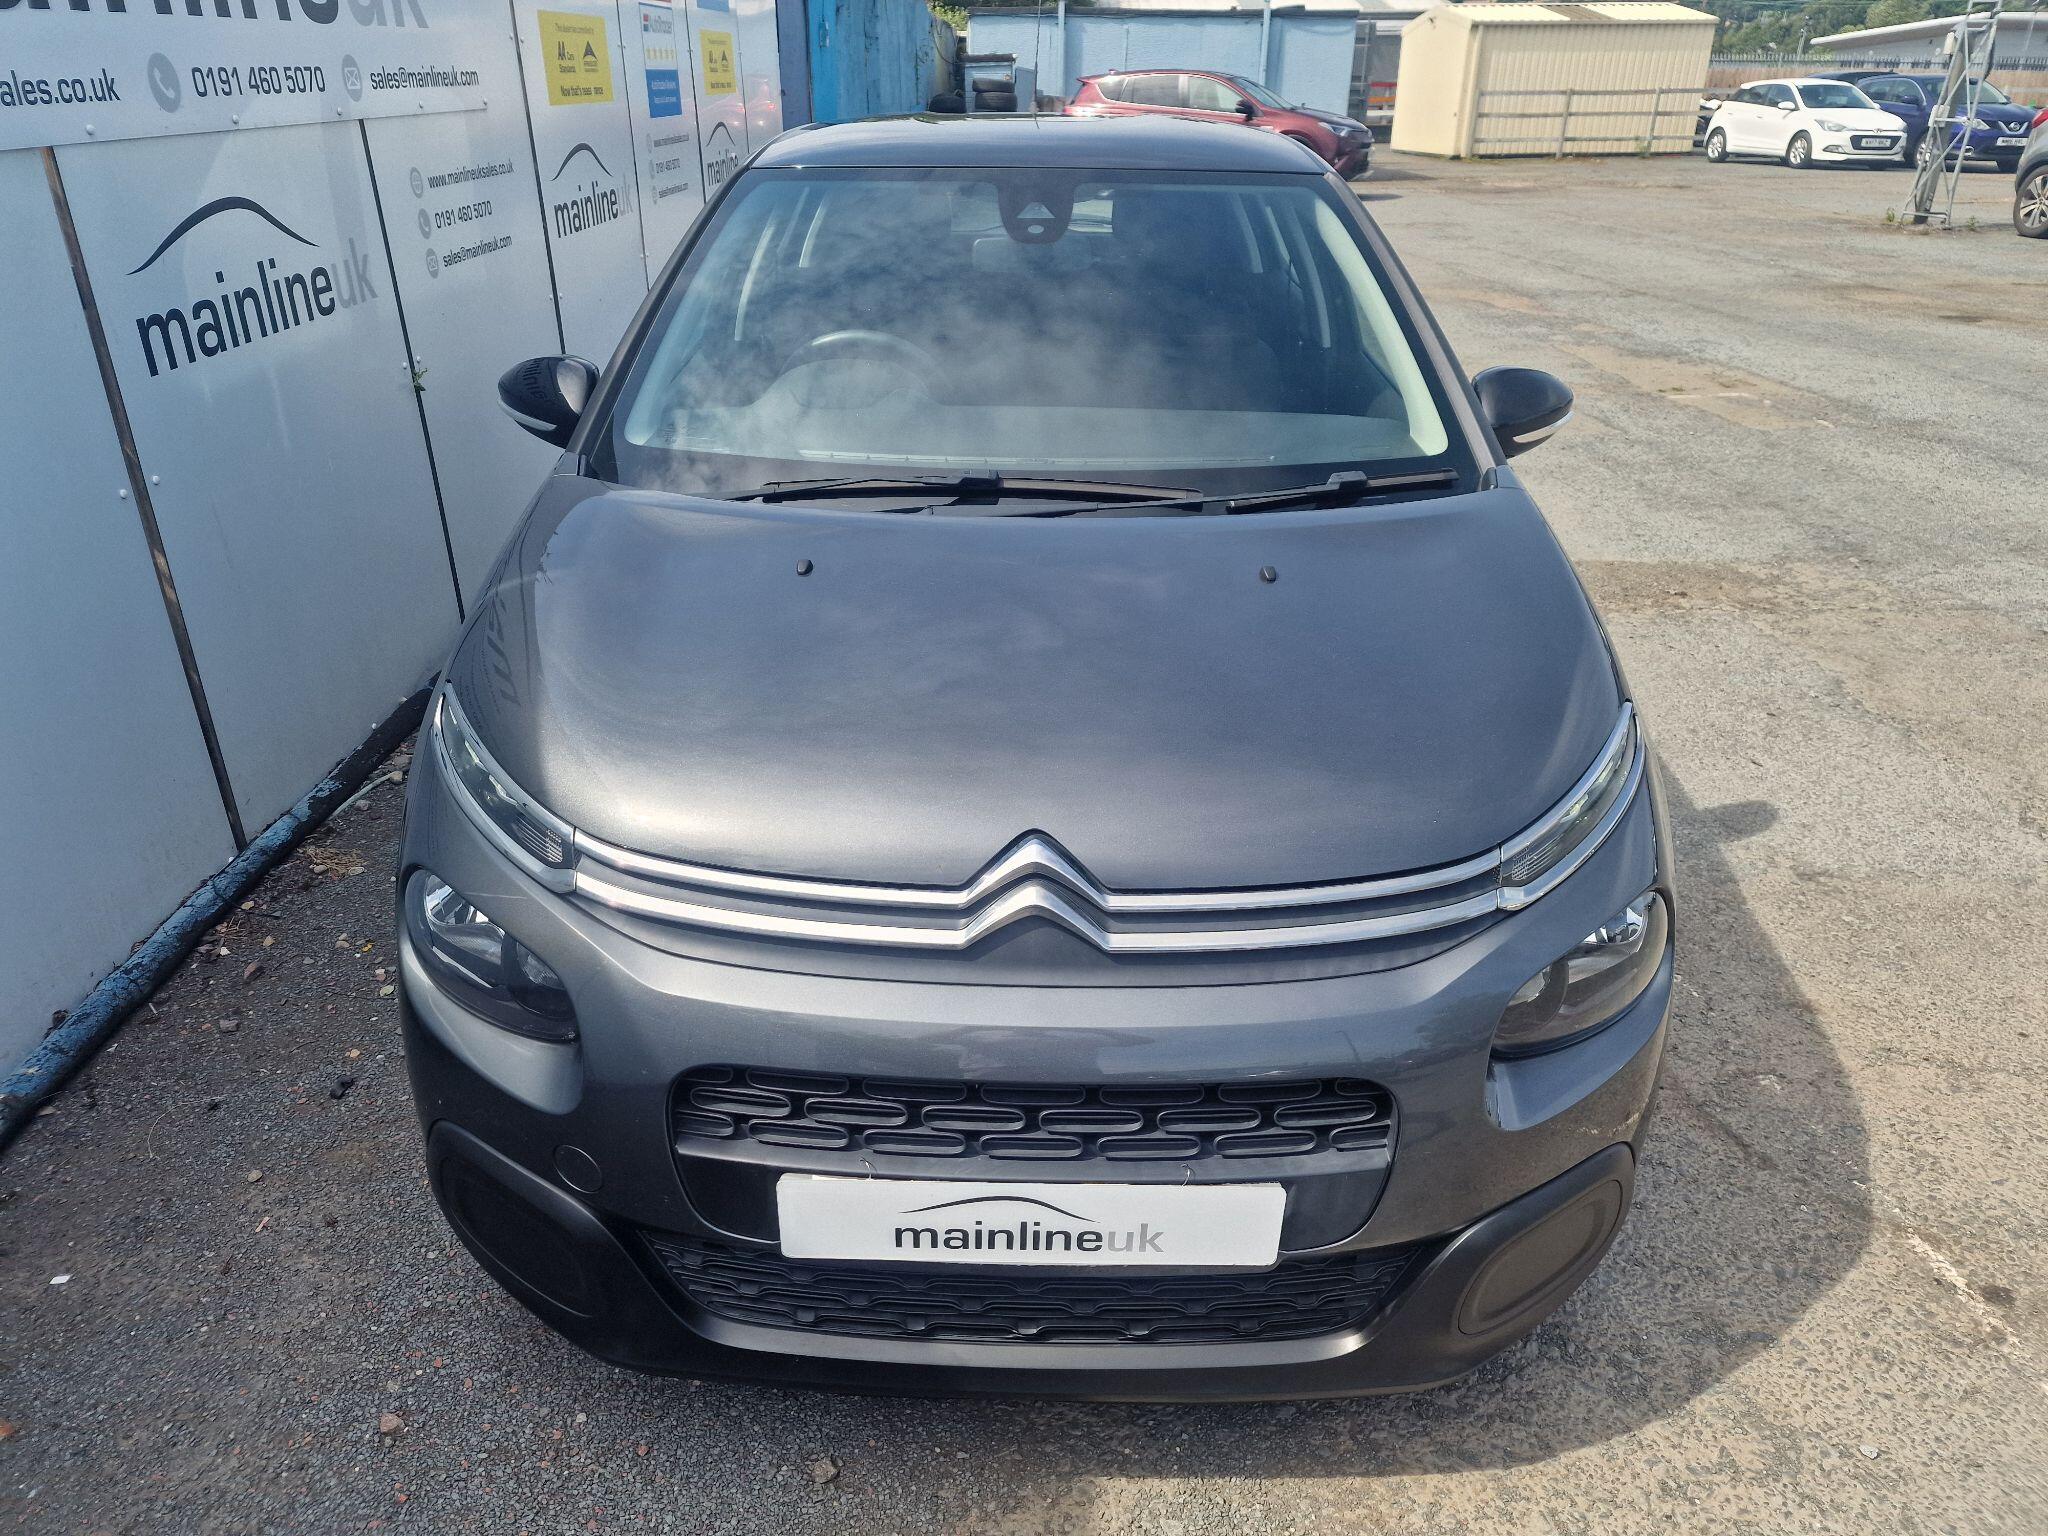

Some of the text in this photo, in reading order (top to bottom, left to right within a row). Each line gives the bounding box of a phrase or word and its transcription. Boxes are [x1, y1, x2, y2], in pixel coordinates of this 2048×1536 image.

[0, 68, 121, 107] ales.co.uk
[191, 66, 326, 98] 0191 460 5070
[369, 65, 480, 90] sales@mainlineuk.com
[427, 158, 515, 189] www.mainlineuksales.co.uk
[434, 200, 493, 229] 0191 460 5070
[553, 172, 634, 239] mainlineuk
[442, 235, 513, 268] sales@mainlineuk.com
[135, 237, 379, 378] mainlineuk
[894, 1220, 1165, 1253] mainlineuk
